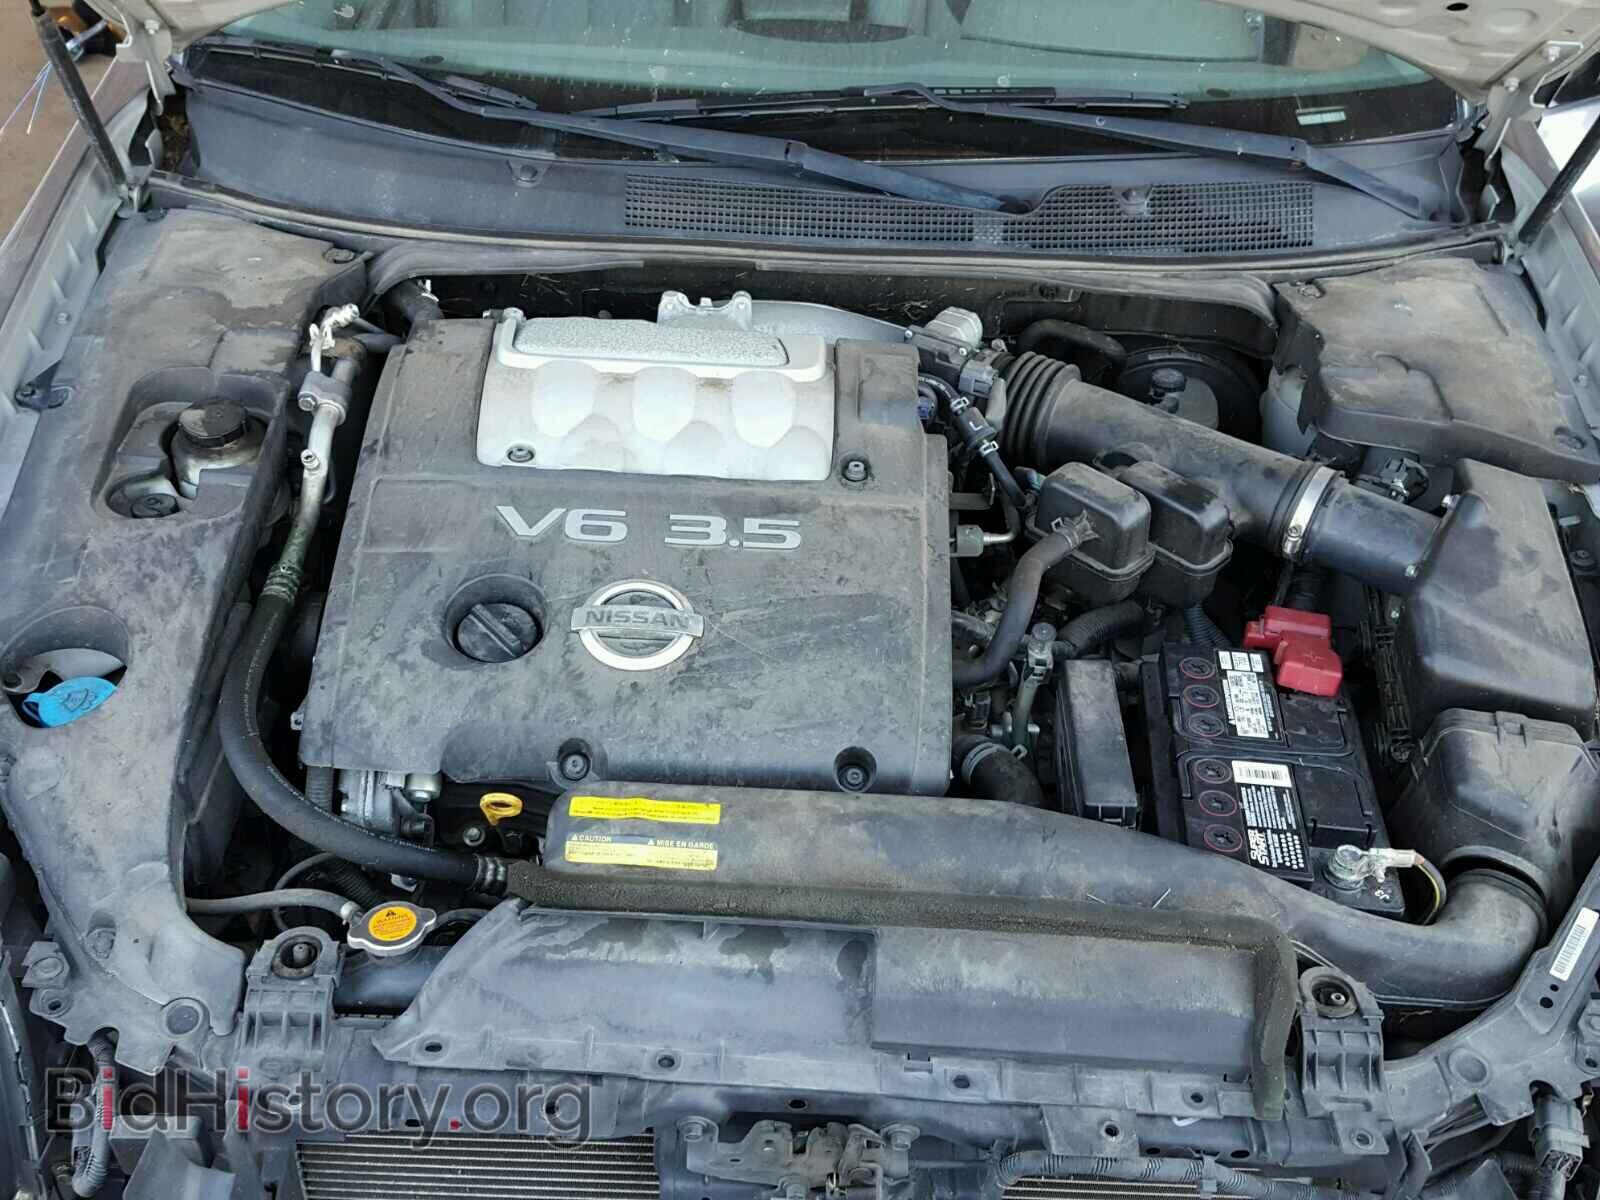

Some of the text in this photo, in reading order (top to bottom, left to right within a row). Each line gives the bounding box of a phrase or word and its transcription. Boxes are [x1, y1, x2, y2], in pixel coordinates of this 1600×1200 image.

[496, 505, 802, 551] V6 3.5
[584, 609, 689, 629] NISSAN
[579, 834, 612, 842] CAUTION
[656, 839, 714, 849] MISE EN GARDE
[1256, 831, 1270, 866] START
